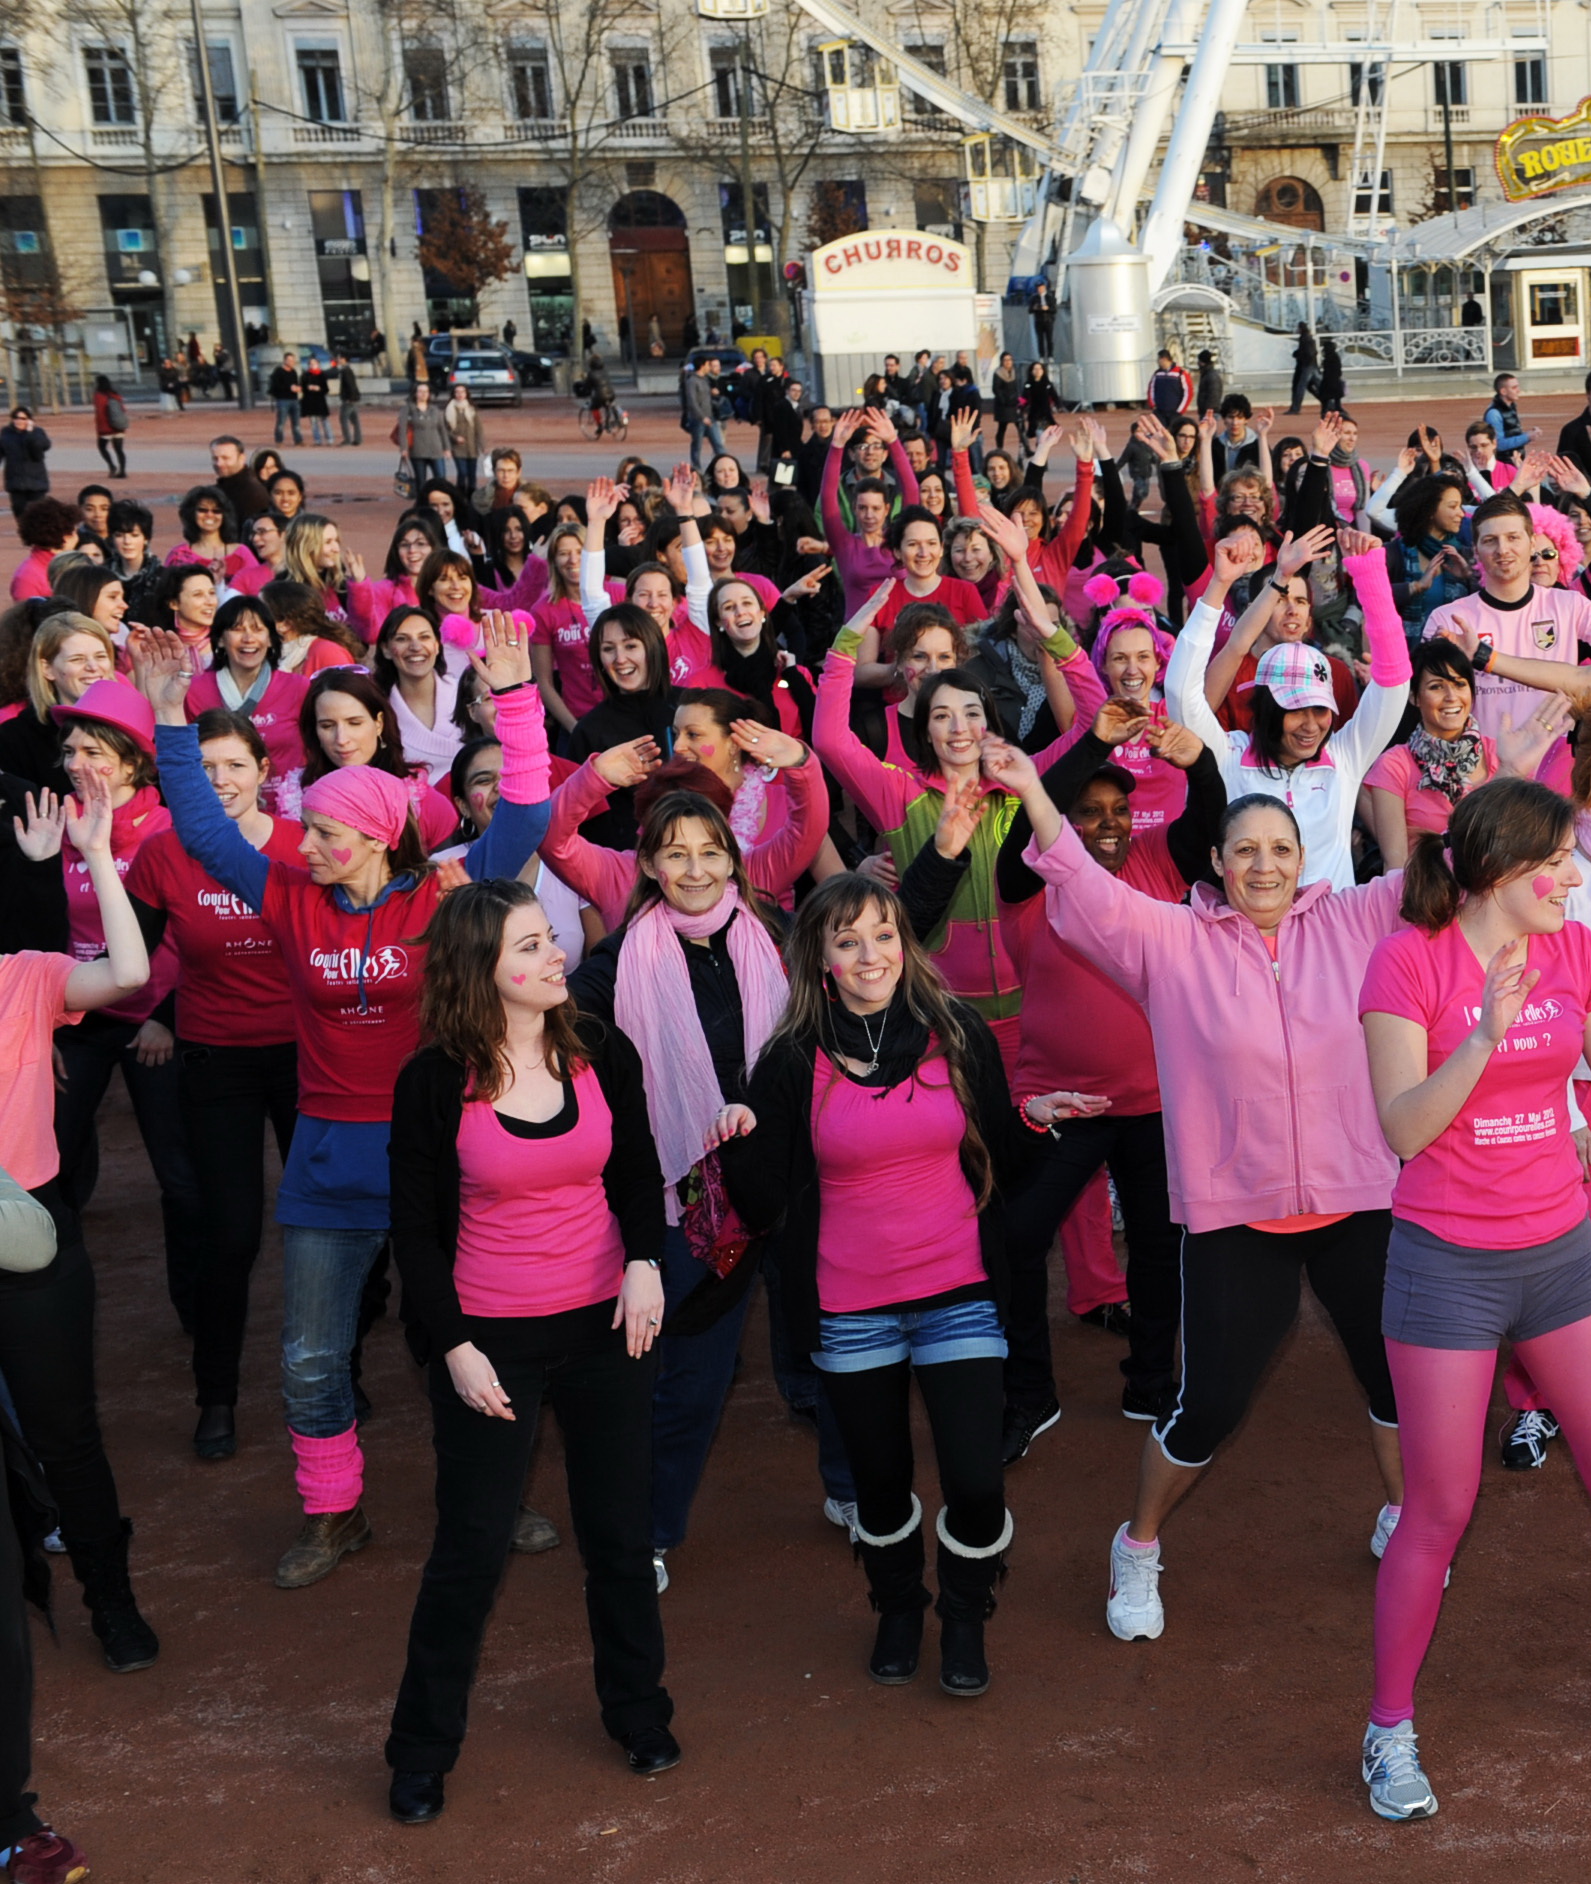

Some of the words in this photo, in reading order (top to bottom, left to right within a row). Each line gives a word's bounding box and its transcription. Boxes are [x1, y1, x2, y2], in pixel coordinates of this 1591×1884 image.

[825, 239, 961, 274] CHURROS
[1476, 685, 1516, 695] PROVINCIA
[198, 889, 230, 906] Courir
[215, 905, 231, 915] Pour
[310, 947, 339, 969] Courir
[323, 968, 339, 979] Pour
[1463, 1006, 1472, 1026] I
[1525, 1003, 1547, 1022] elles
[1513, 1036, 1538, 1052] vous
[1542, 1032, 1552, 1047] ?
[1474, 1116, 1512, 1128] Dimanche
[1515, 1113, 1525, 1125] 27
[1528, 1111, 1541, 1123] Mai
